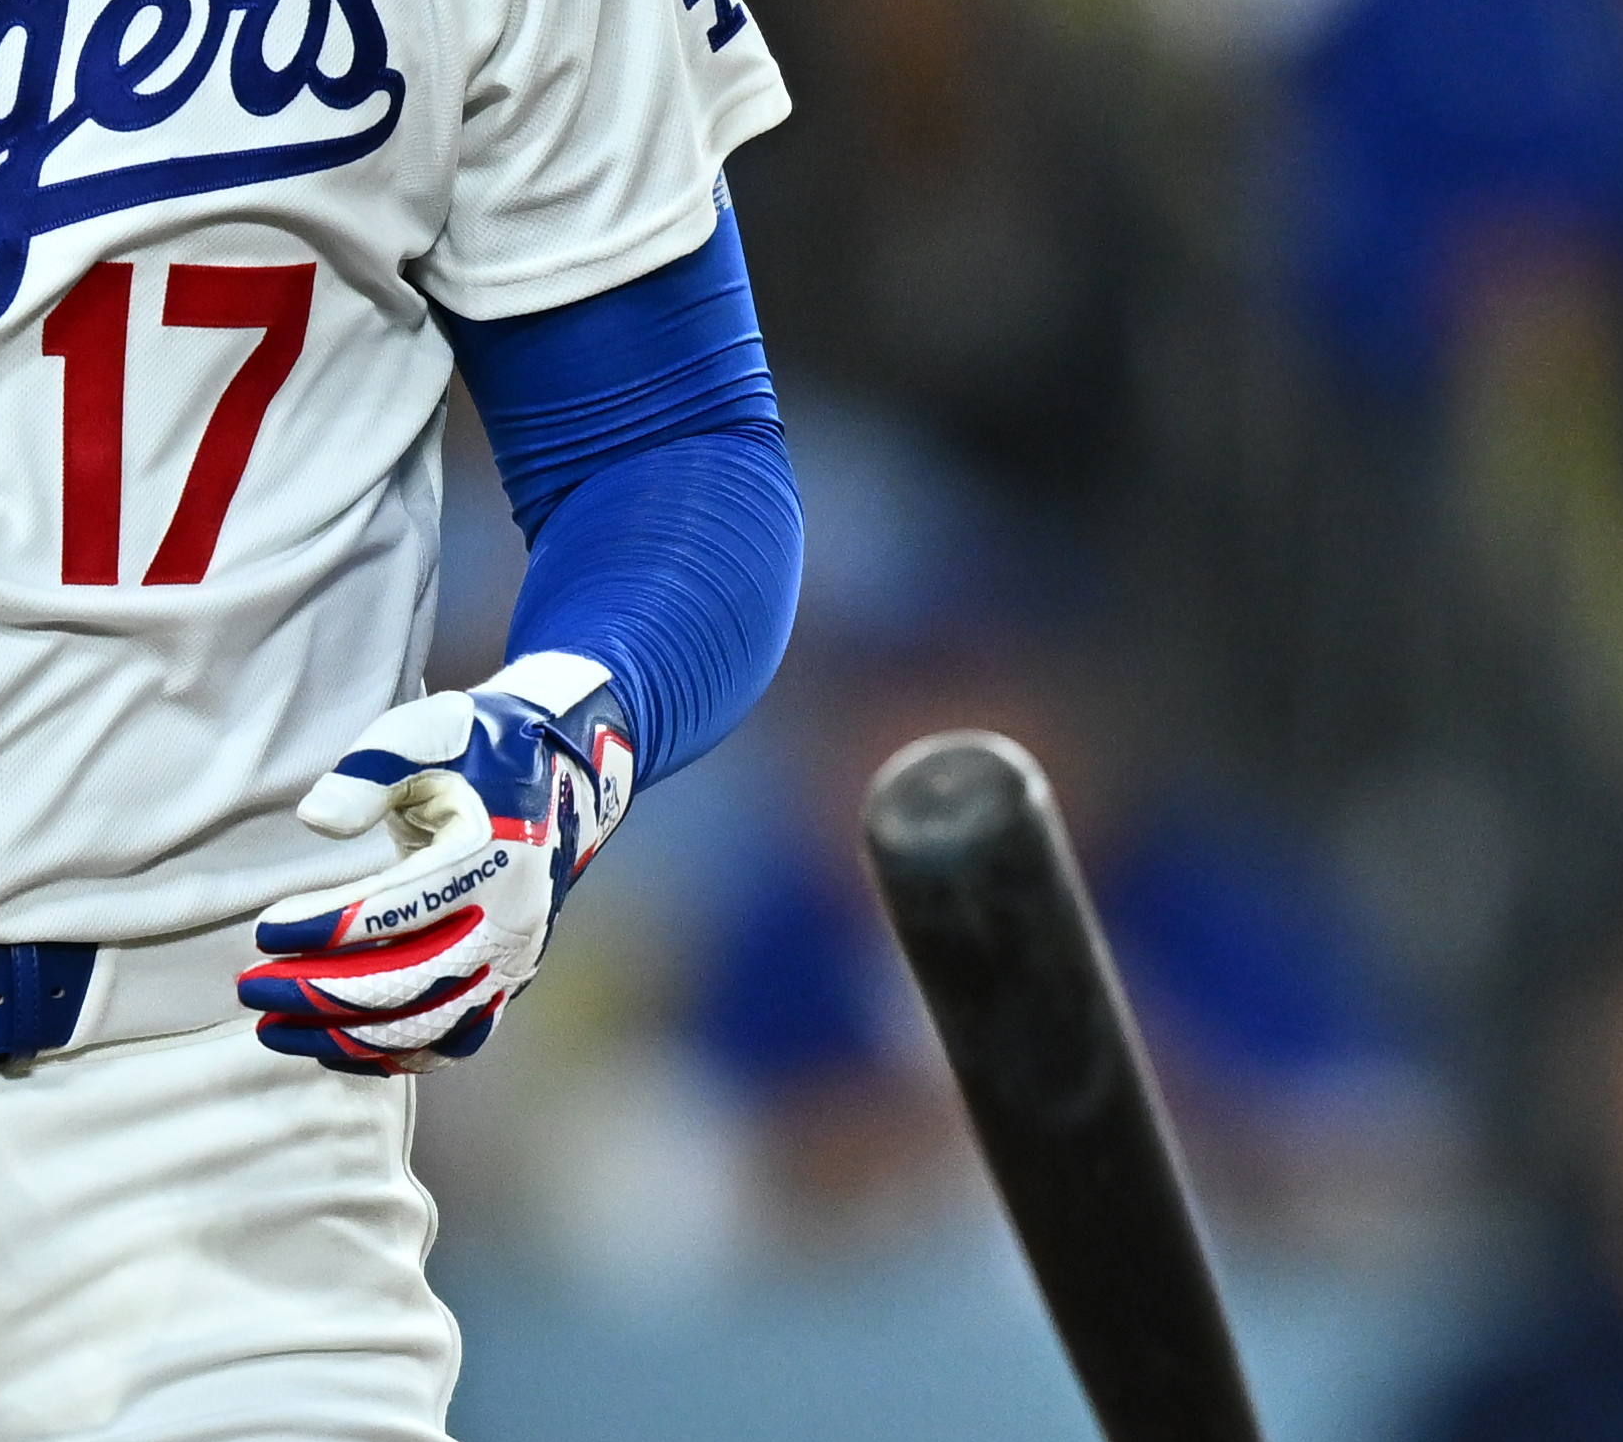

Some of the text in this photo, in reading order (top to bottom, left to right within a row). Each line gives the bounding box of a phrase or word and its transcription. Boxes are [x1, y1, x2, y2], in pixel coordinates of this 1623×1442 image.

[41, 260, 318, 586] 17
[365, 849, 510, 934] new balance
